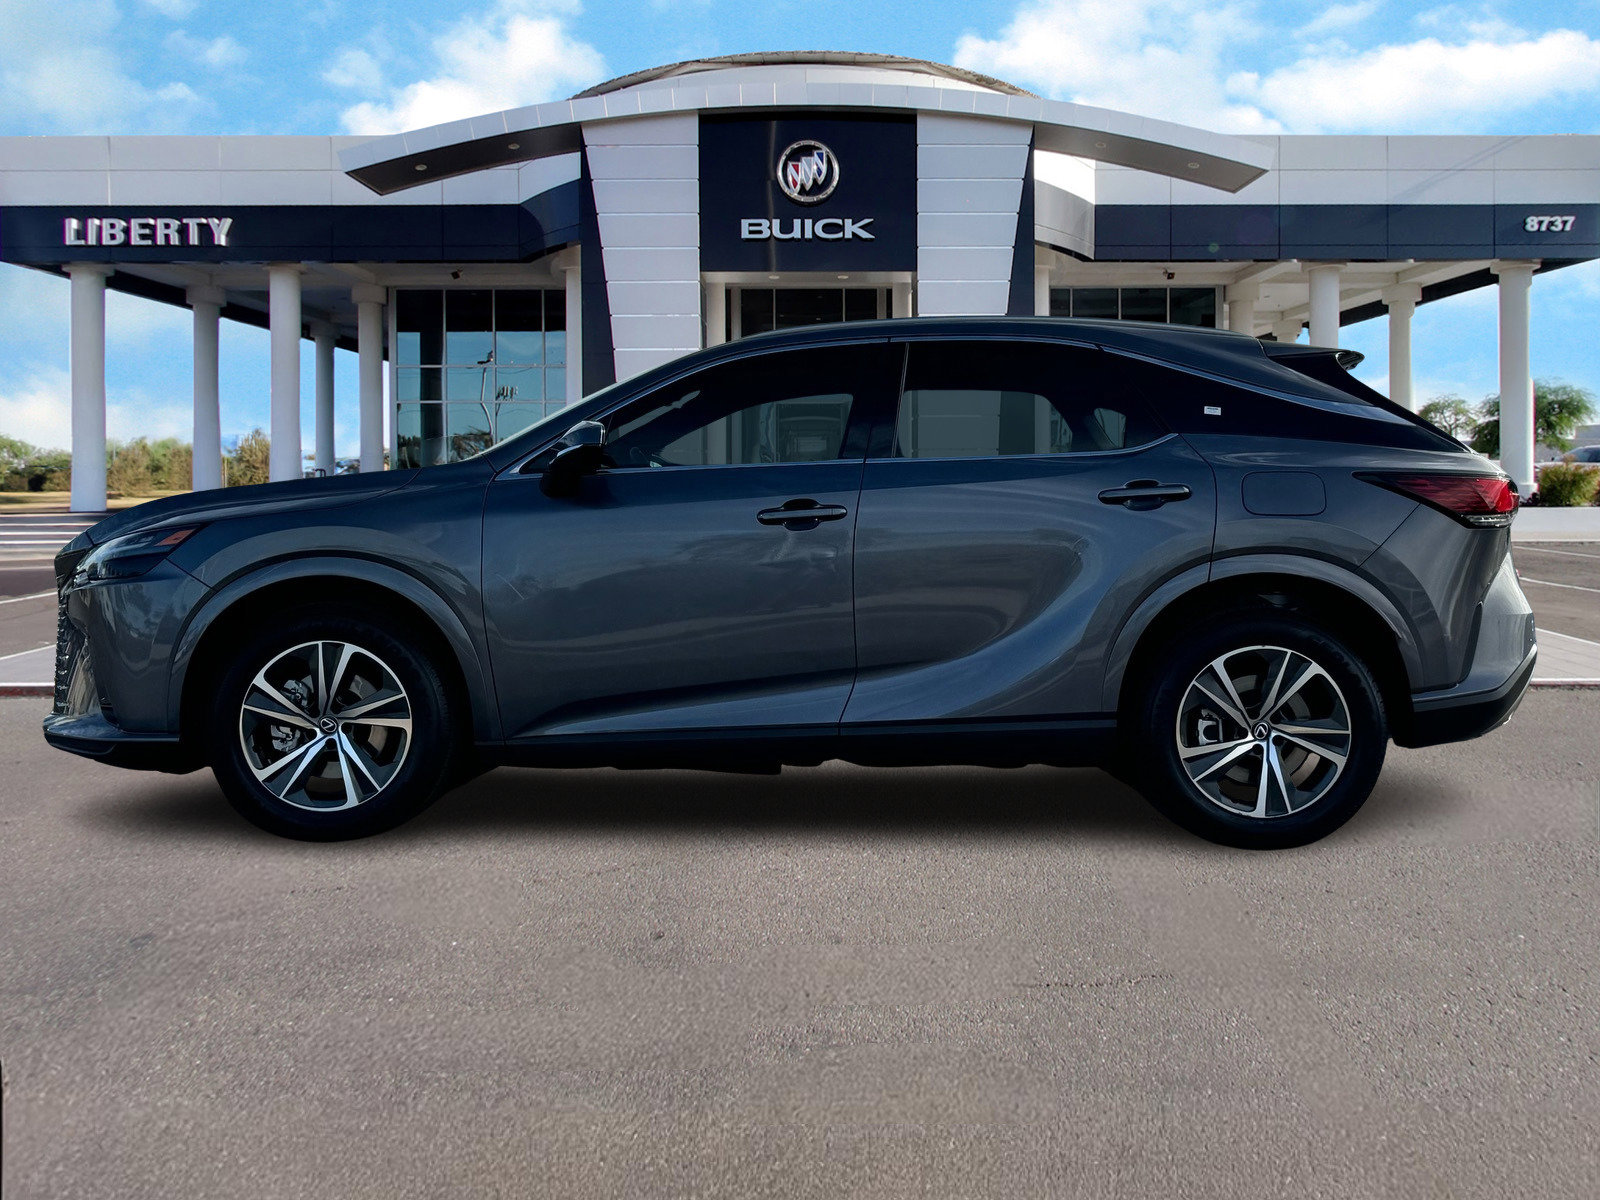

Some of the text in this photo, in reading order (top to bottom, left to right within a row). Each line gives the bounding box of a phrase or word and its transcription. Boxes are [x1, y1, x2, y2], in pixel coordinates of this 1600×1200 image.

[64, 217, 233, 246] LIBERTY
[741, 218, 875, 239] BUICK
[1525, 215, 1576, 232] 8737
